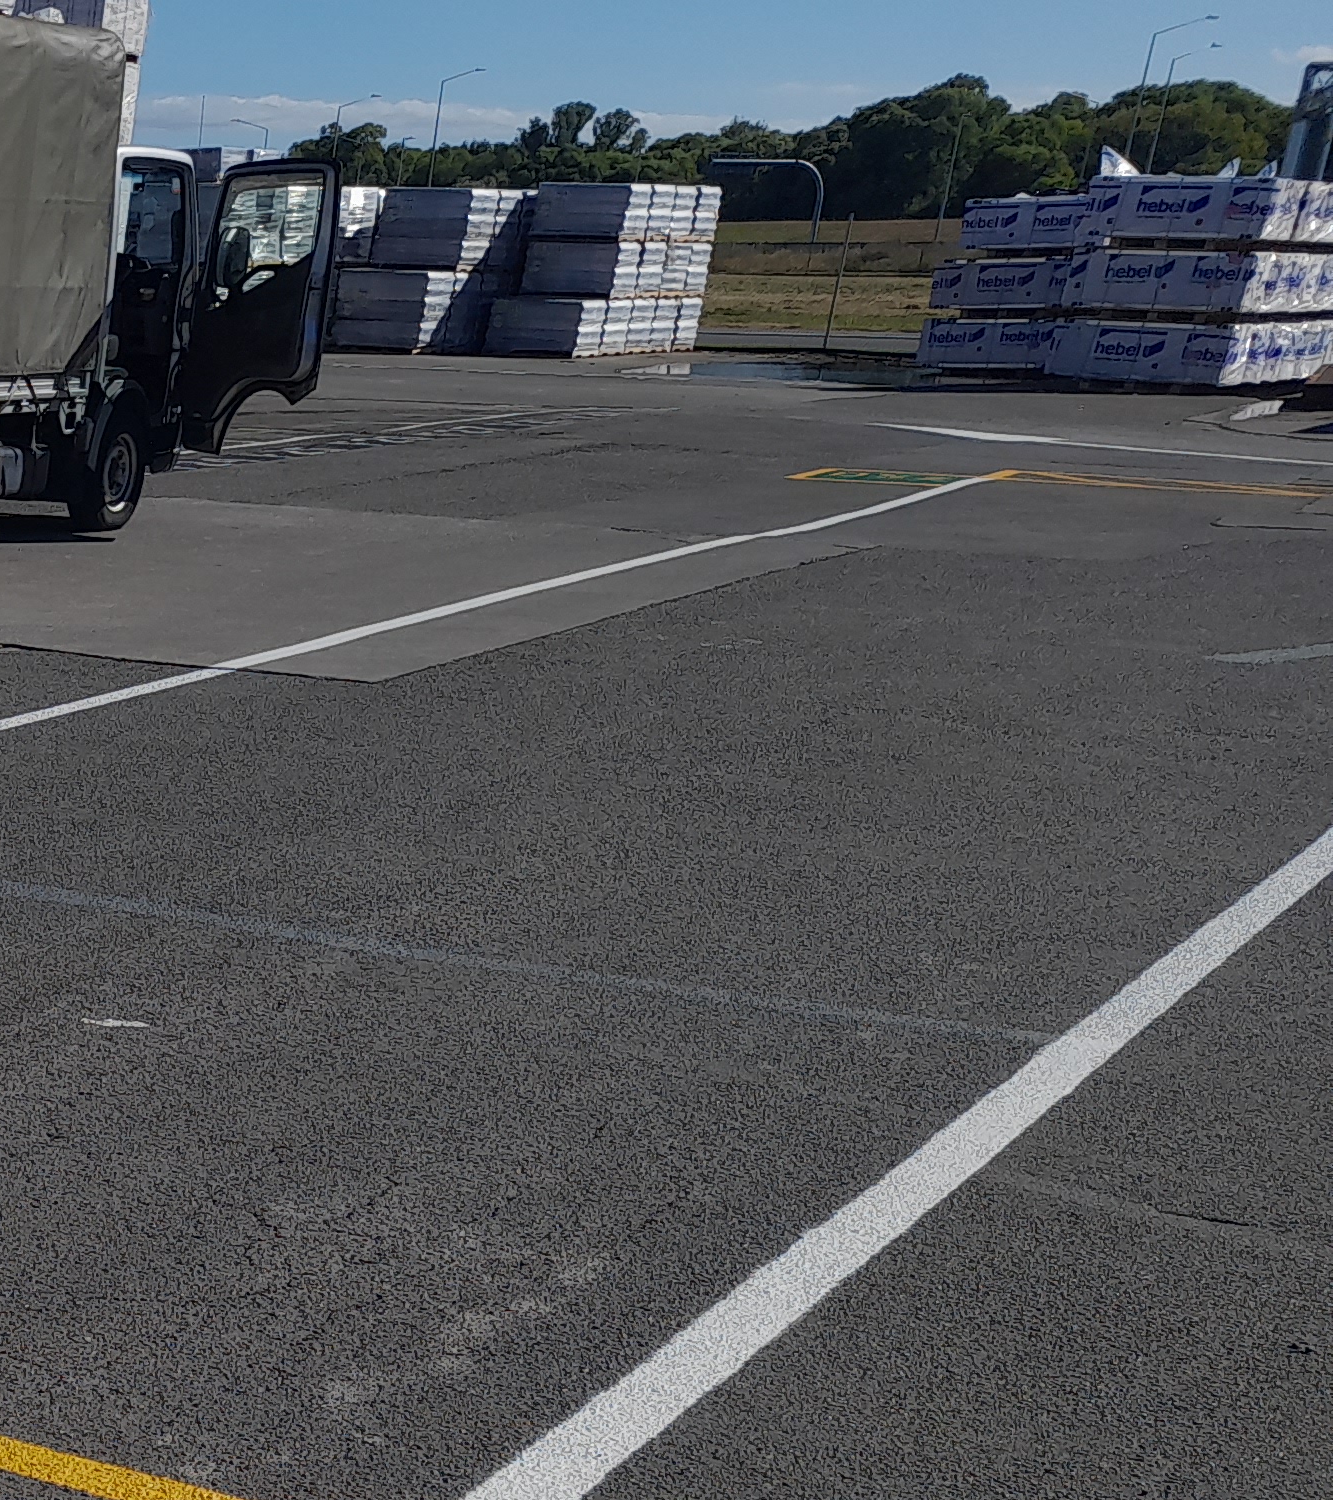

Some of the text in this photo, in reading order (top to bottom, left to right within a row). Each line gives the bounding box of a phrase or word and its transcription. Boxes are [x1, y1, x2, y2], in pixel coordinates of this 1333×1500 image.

[1136, 198, 1188, 213] hebel
[1105, 263, 1153, 279] hebel
[1192, 263, 1240, 282] hebel
[976, 275, 1015, 289] hebel
[928, 331, 967, 344] hebel
[1094, 341, 1142, 357] hebel
